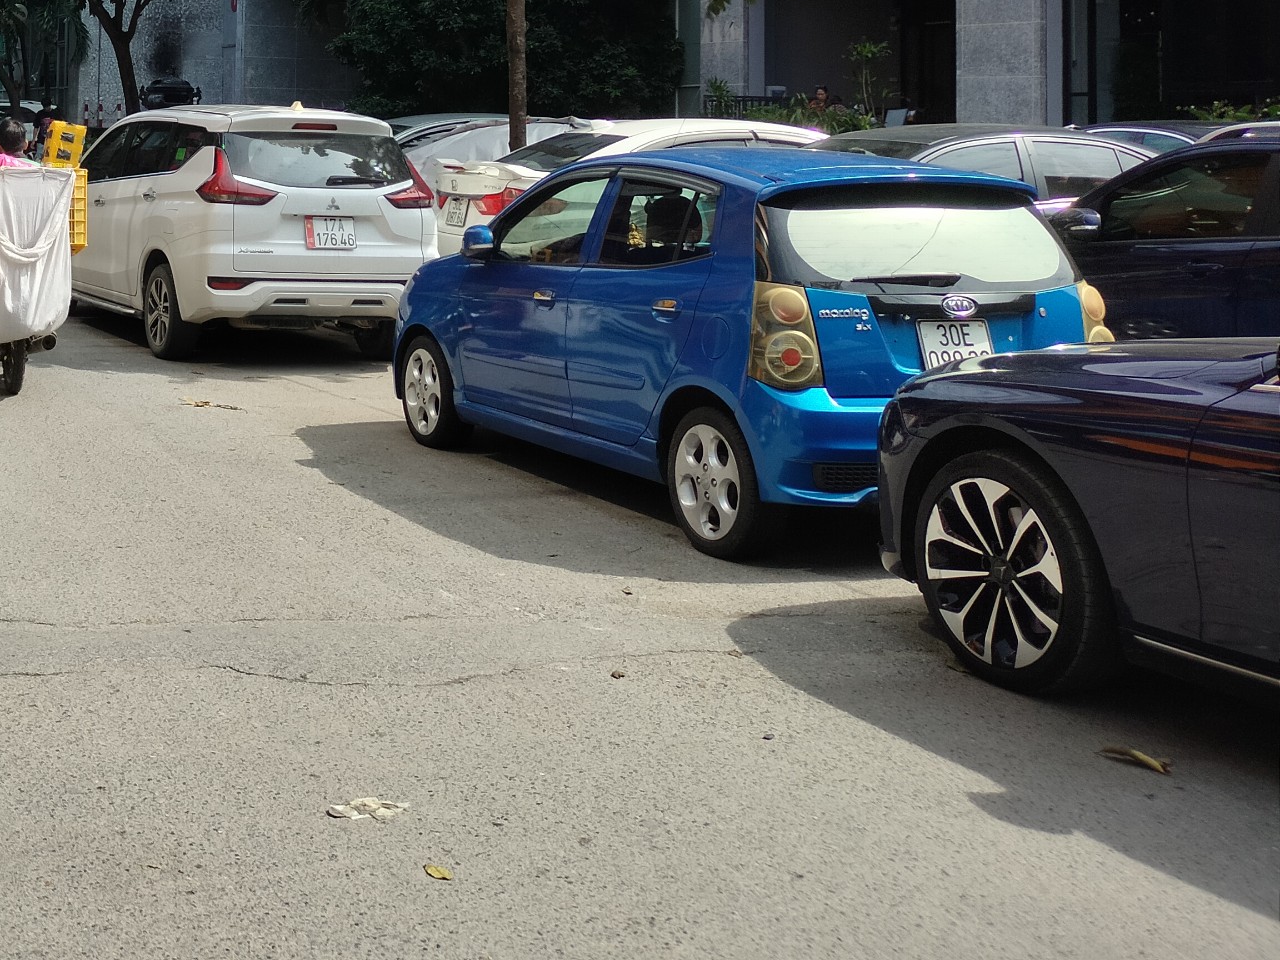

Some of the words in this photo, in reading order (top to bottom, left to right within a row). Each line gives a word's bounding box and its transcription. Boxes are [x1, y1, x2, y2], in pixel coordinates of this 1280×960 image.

[324, 219, 345, 232] 17A
[316, 233, 355, 246] 176.46
[947, 299, 971, 312] KIA
[936, 324, 974, 347] 30E
